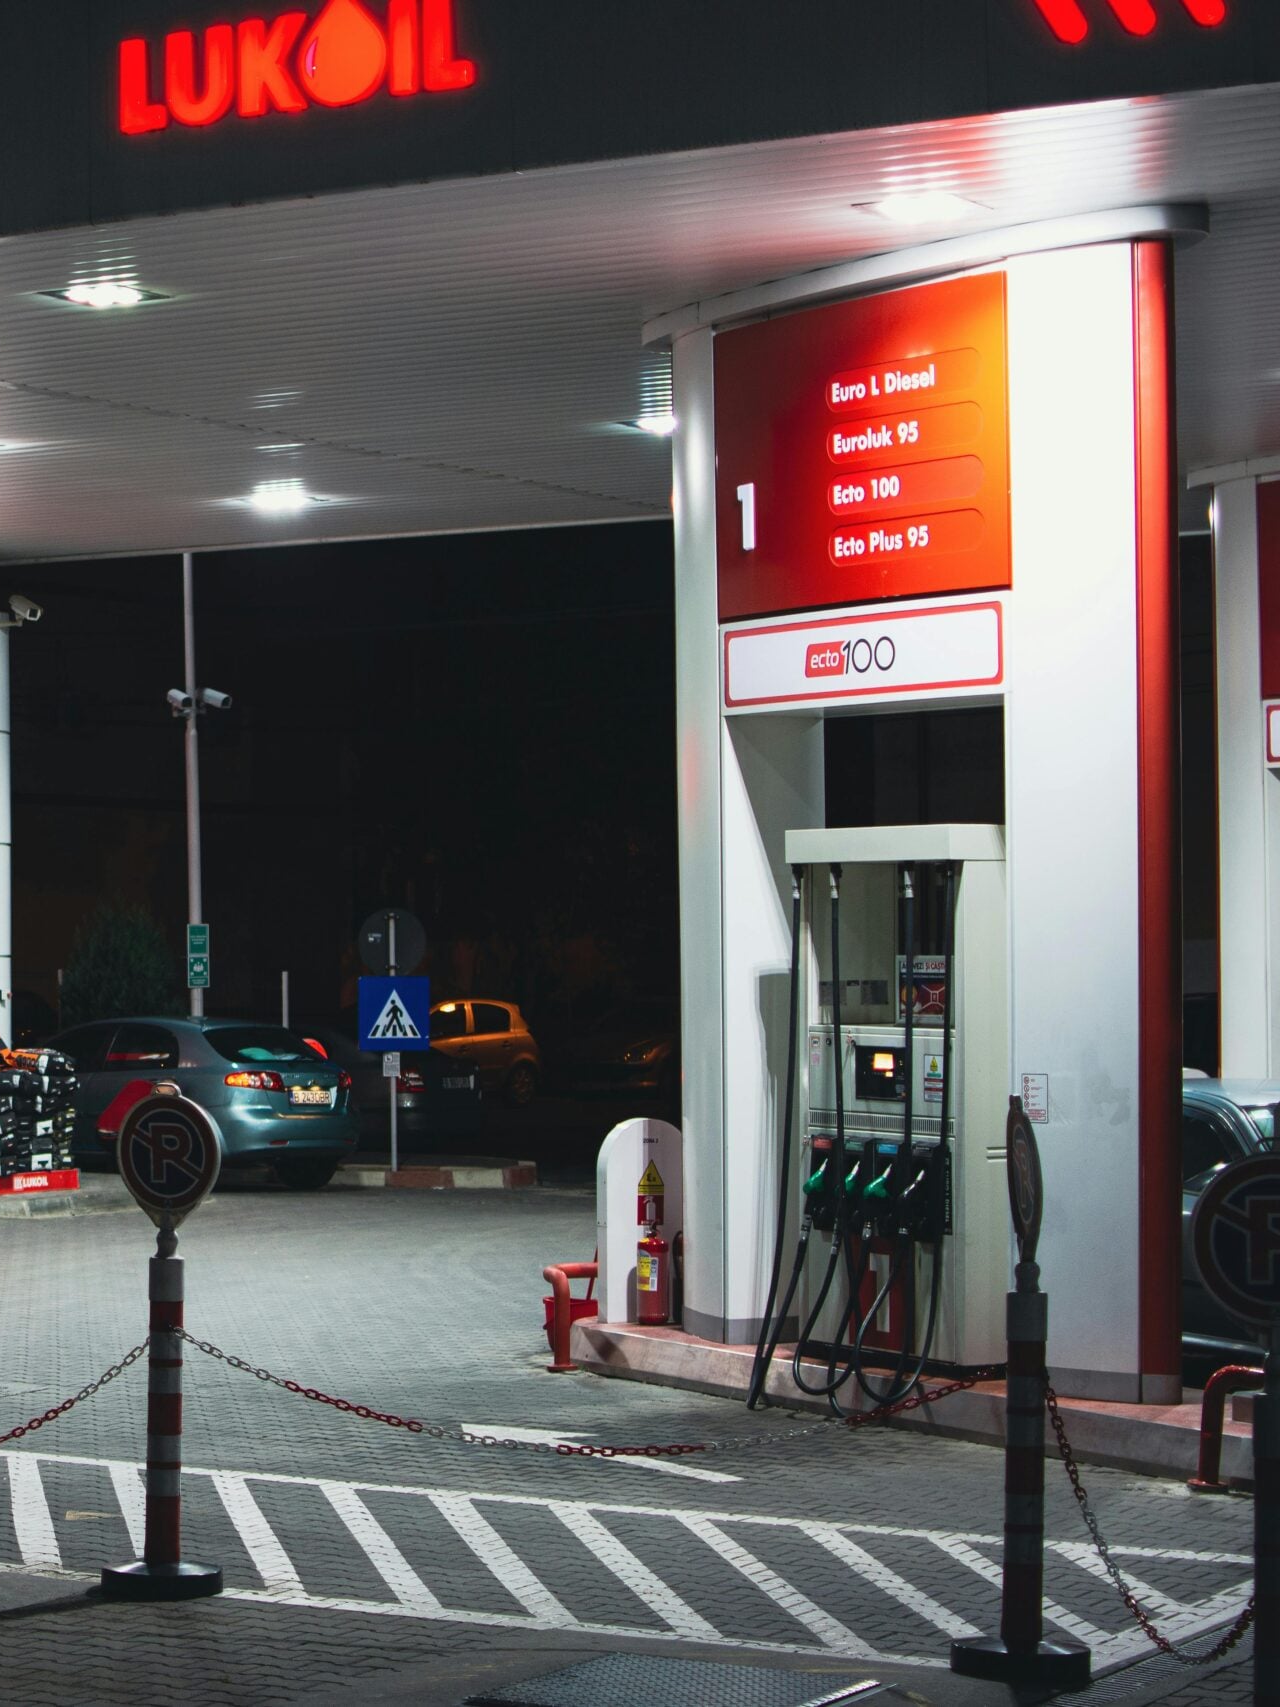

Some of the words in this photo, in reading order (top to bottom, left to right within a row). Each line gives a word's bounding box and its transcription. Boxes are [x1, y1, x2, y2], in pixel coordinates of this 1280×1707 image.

[118, 0, 477, 136] LUKOIL
[831, 382, 867, 404] Euro
[871, 375, 880, 396] L
[884, 363, 936, 394] Diesel
[833, 425, 893, 455] Euroluk
[897, 420, 919, 444] 95
[832, 484, 865, 505] Ecto
[870, 475, 900, 500] 100
[736, 481, 756, 551] 1
[834, 536, 865, 558] Ecto
[870, 529, 903, 553] Plus
[907, 525, 929, 548] 95
[22, 1176, 49, 1188] LUKOIL
